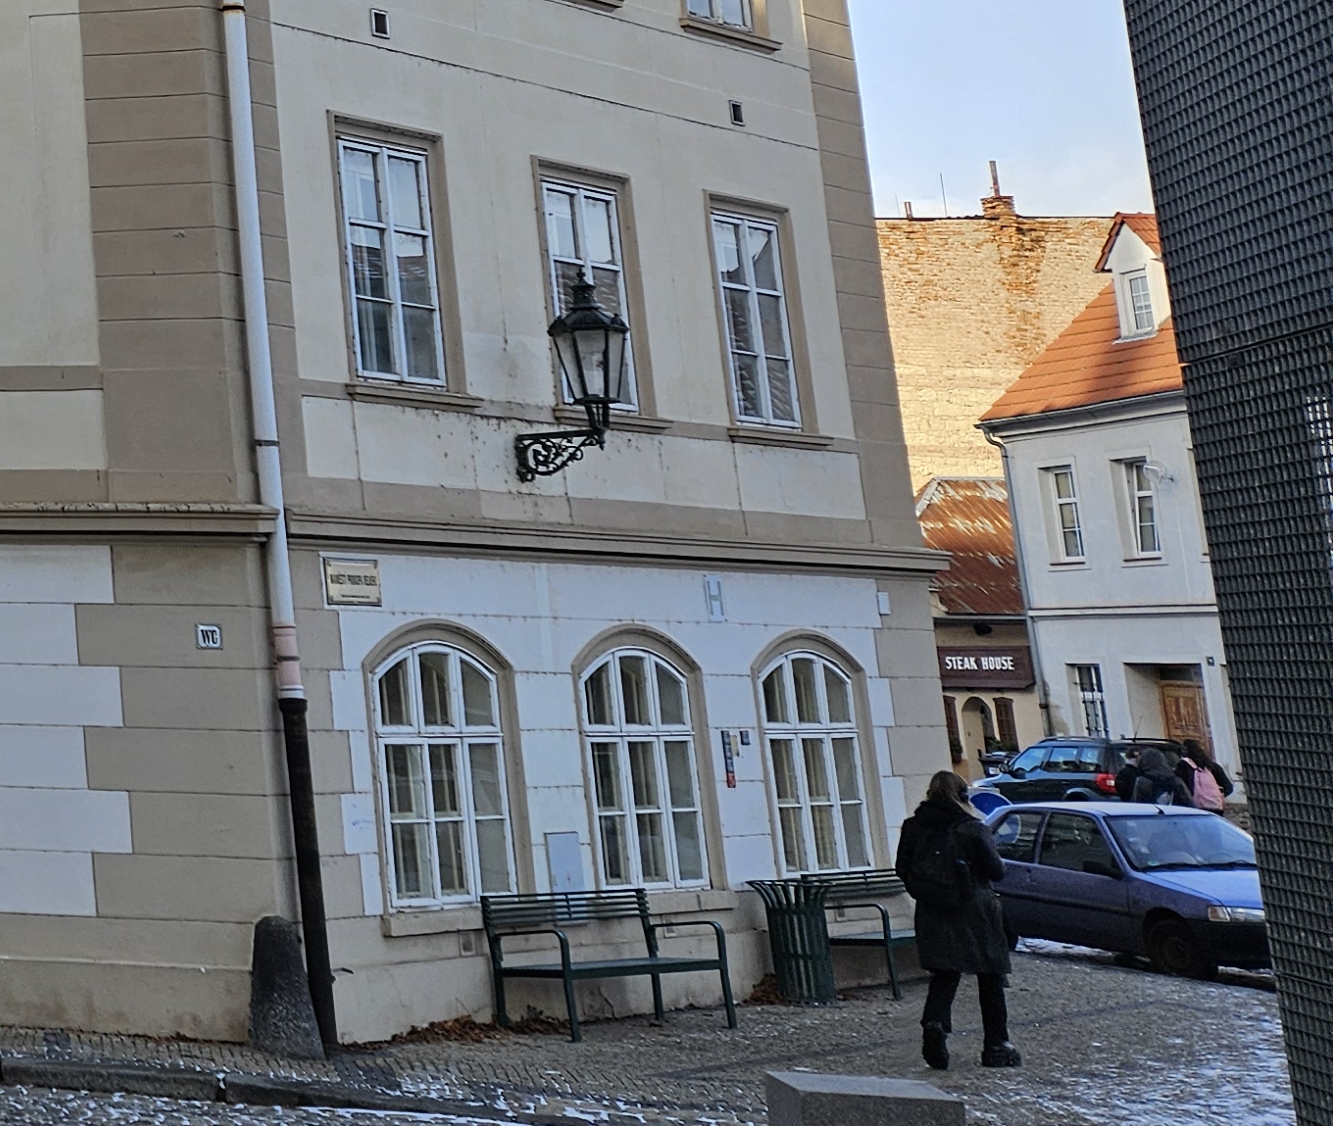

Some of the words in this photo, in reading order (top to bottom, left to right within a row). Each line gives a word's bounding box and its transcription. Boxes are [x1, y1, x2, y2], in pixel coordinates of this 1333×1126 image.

[706, 580, 725, 616] H
[945, 656, 978, 671] STEAK
[981, 656, 1015, 671] HOUSE
